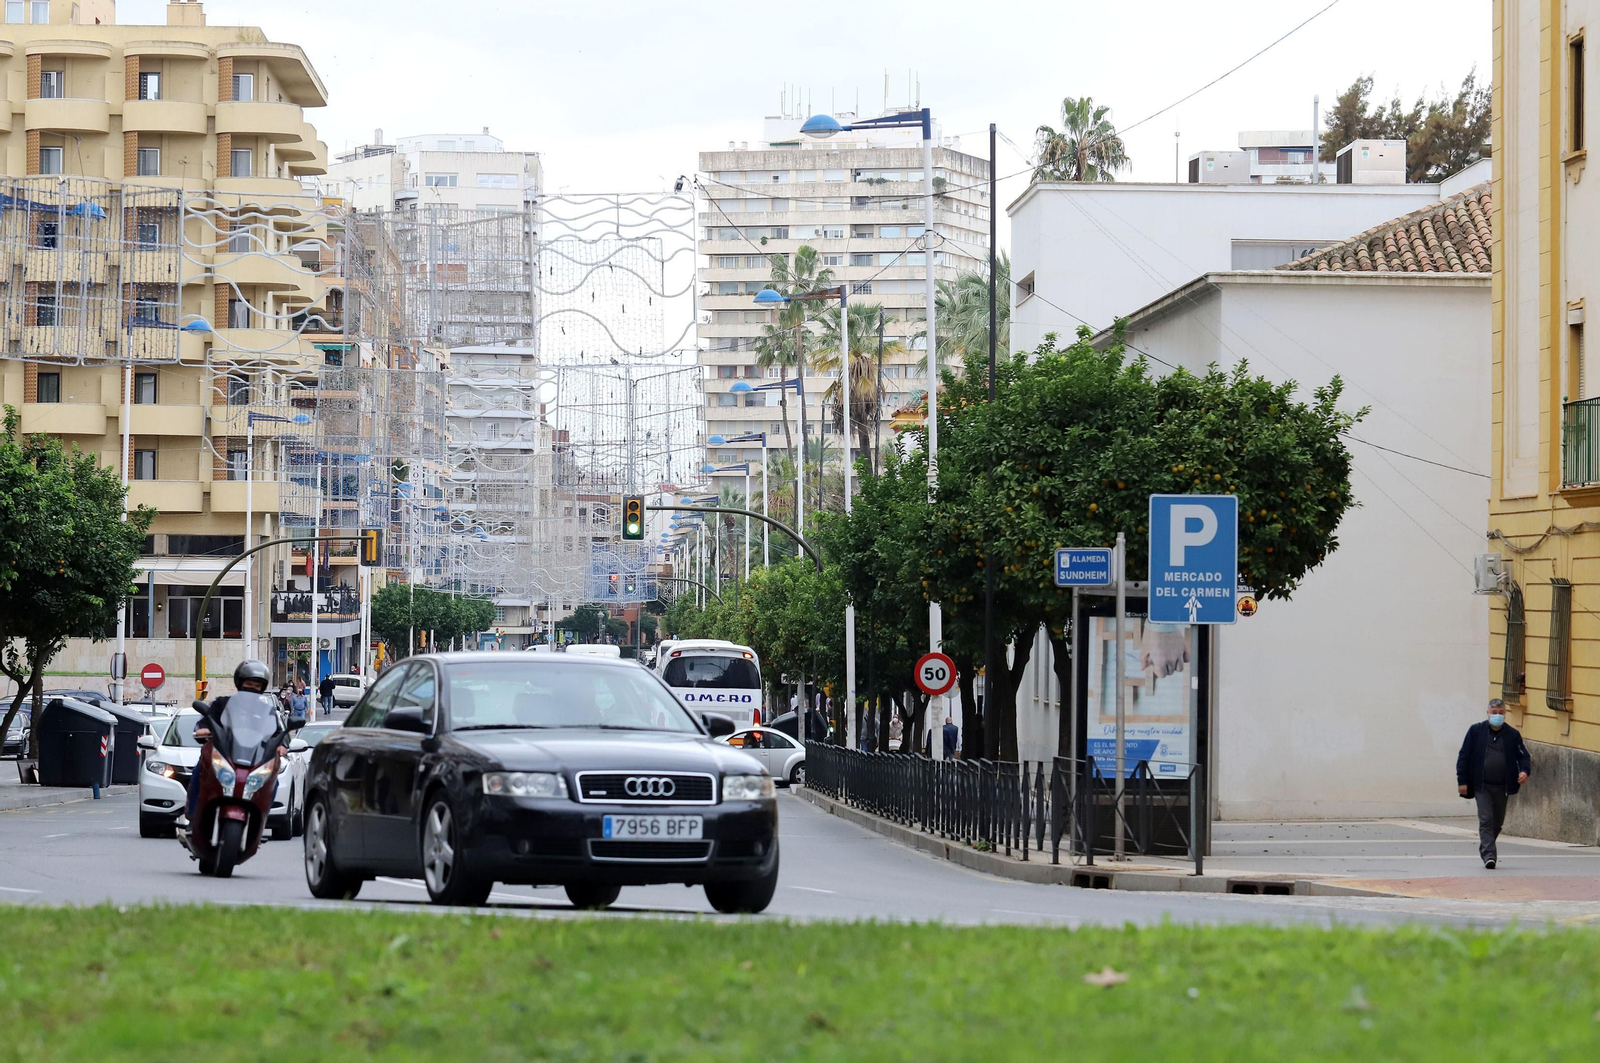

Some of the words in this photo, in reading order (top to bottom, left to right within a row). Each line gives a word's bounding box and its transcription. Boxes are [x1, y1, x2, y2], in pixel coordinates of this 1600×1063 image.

[1169, 504, 1218, 567] P
[1071, 555, 1106, 563] ALAMEDA
[1059, 571, 1107, 580] SUNDHEIM
[1164, 572, 1222, 582] MERCADO
[1156, 587, 1178, 597] DEL
[1181, 587, 1230, 597] CARMEN
[924, 667, 946, 681] 50
[684, 693, 752, 703] OMERO
[615, 819, 660, 835] 7956
[667, 819, 699, 836] BFP
